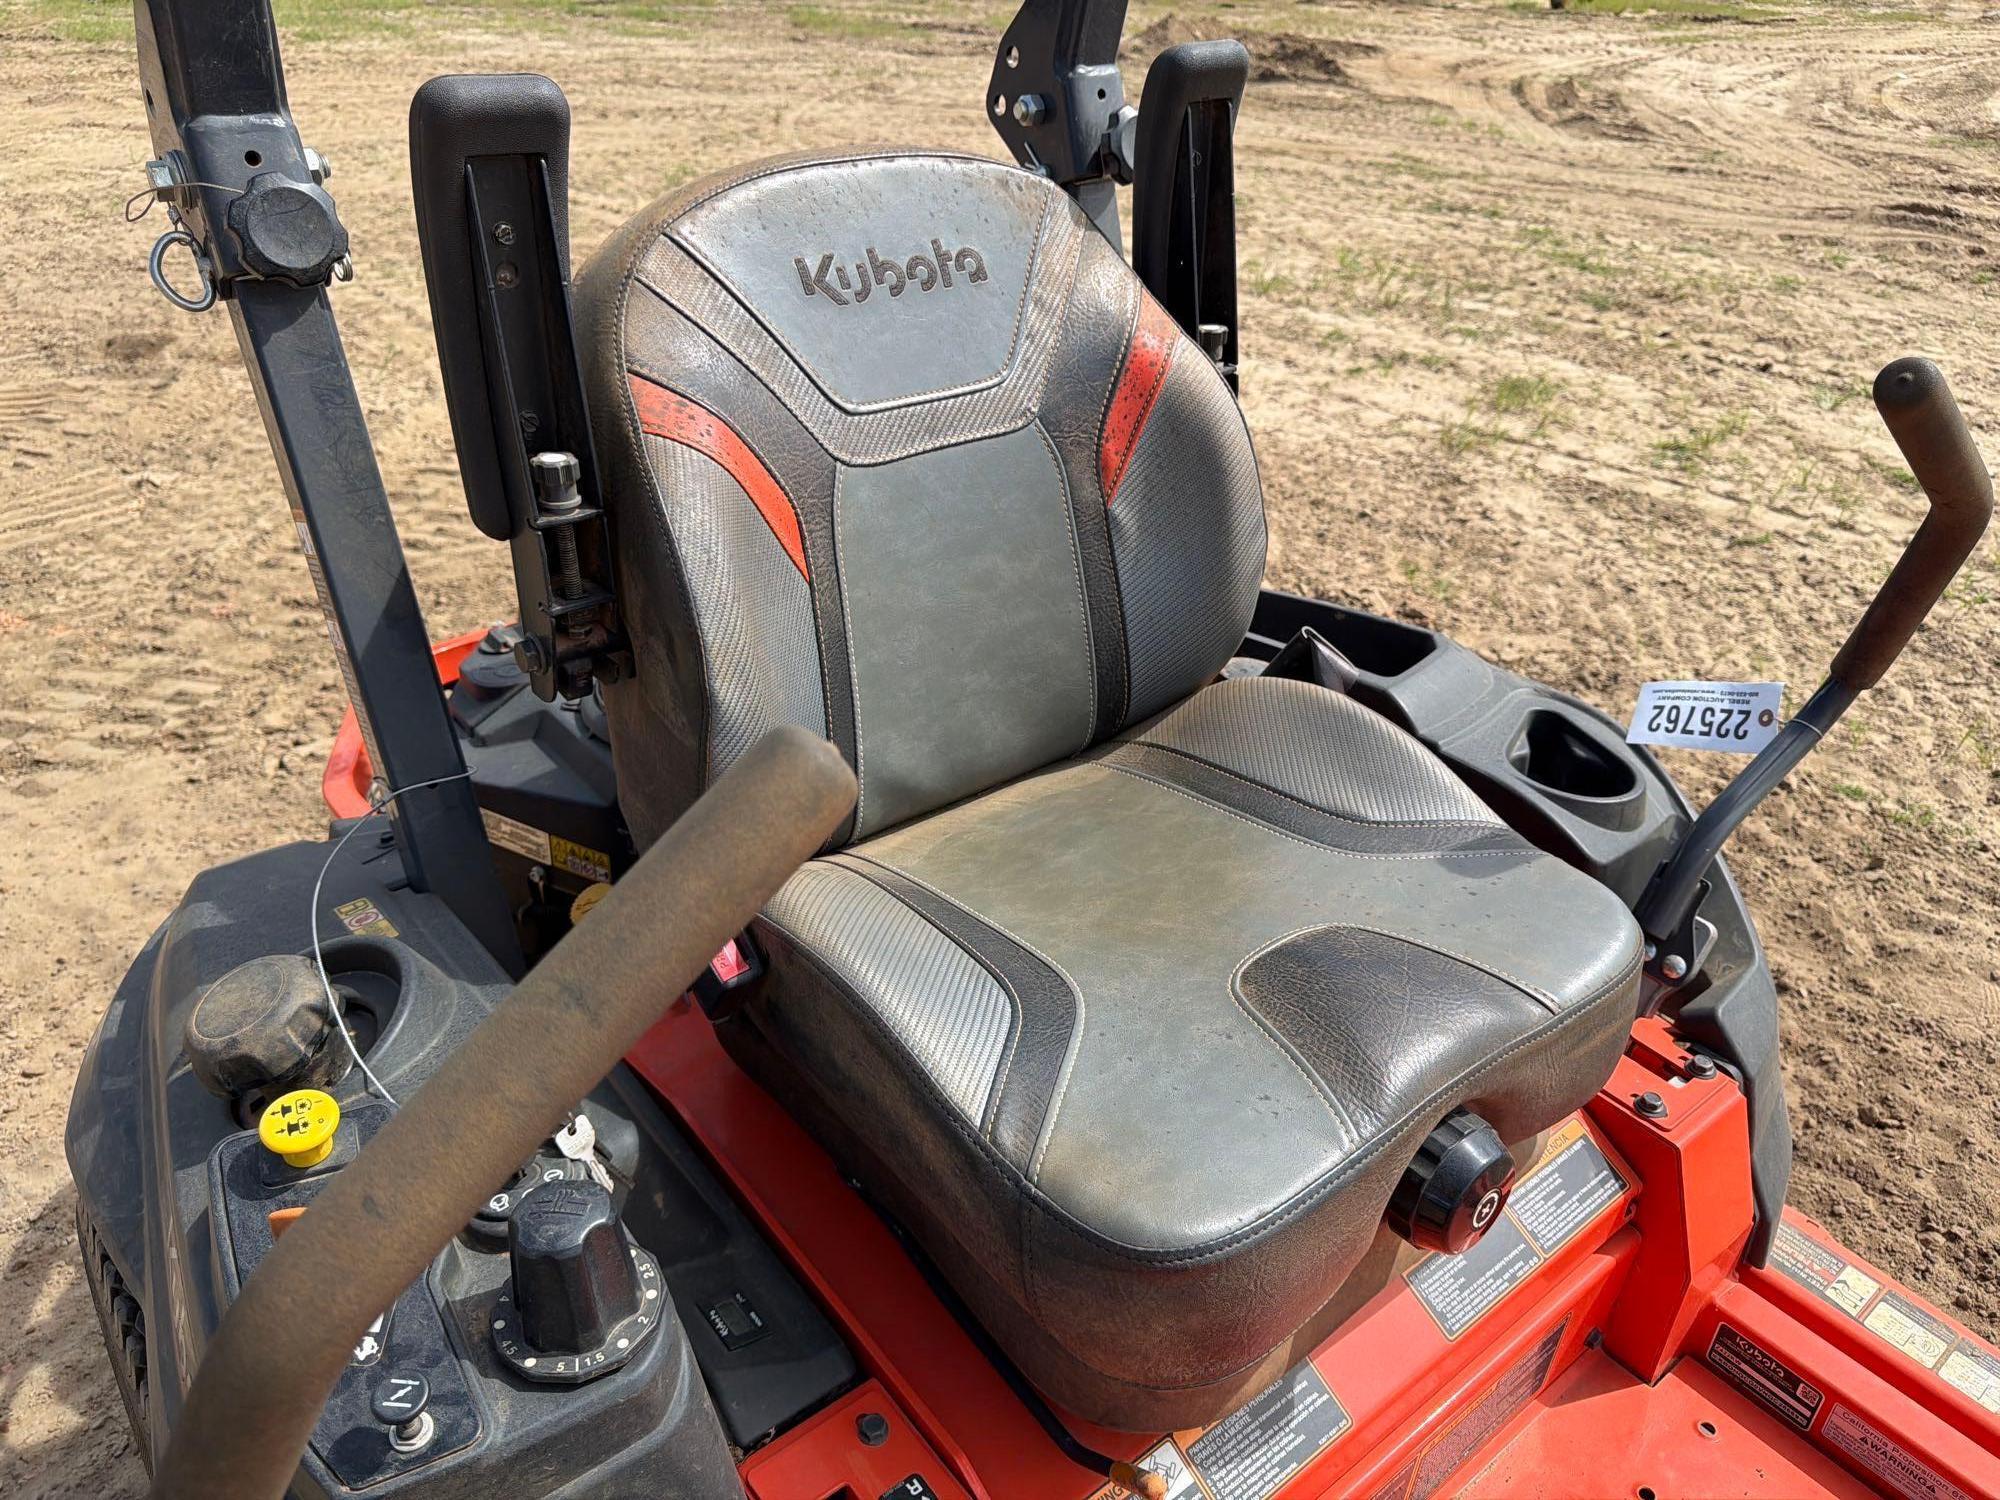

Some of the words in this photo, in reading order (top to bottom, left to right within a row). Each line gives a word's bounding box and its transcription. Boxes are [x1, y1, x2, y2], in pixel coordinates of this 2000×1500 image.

[794, 238, 988, 306] Kubota
[1647, 704, 1752, 740] 225762
[639, 1263, 655, 1279] 2.5
[638, 1315, 650, 1324] 2
[556, 1362, 566, 1372] 5
[584, 1352, 605, 1366] 1.5
[1733, 1335, 1787, 1378] Kubota
[1187, 1440, 1206, 1457] PARA
[1202, 1425, 1224, 1445] EVITAR
[1221, 1403, 1250, 1430] LESIONES
[1192, 1442, 1218, 1465] GRAVES
[1220, 1431, 1231, 1442] LA
[1227, 1413, 1252, 1436] MUERTE
[1841, 1411, 1890, 1447] California
[1889, 1446, 1950, 1491] Proposition
[1868, 1441, 1928, 1486] WARNING
[905, 1478, 923, 1495] R
